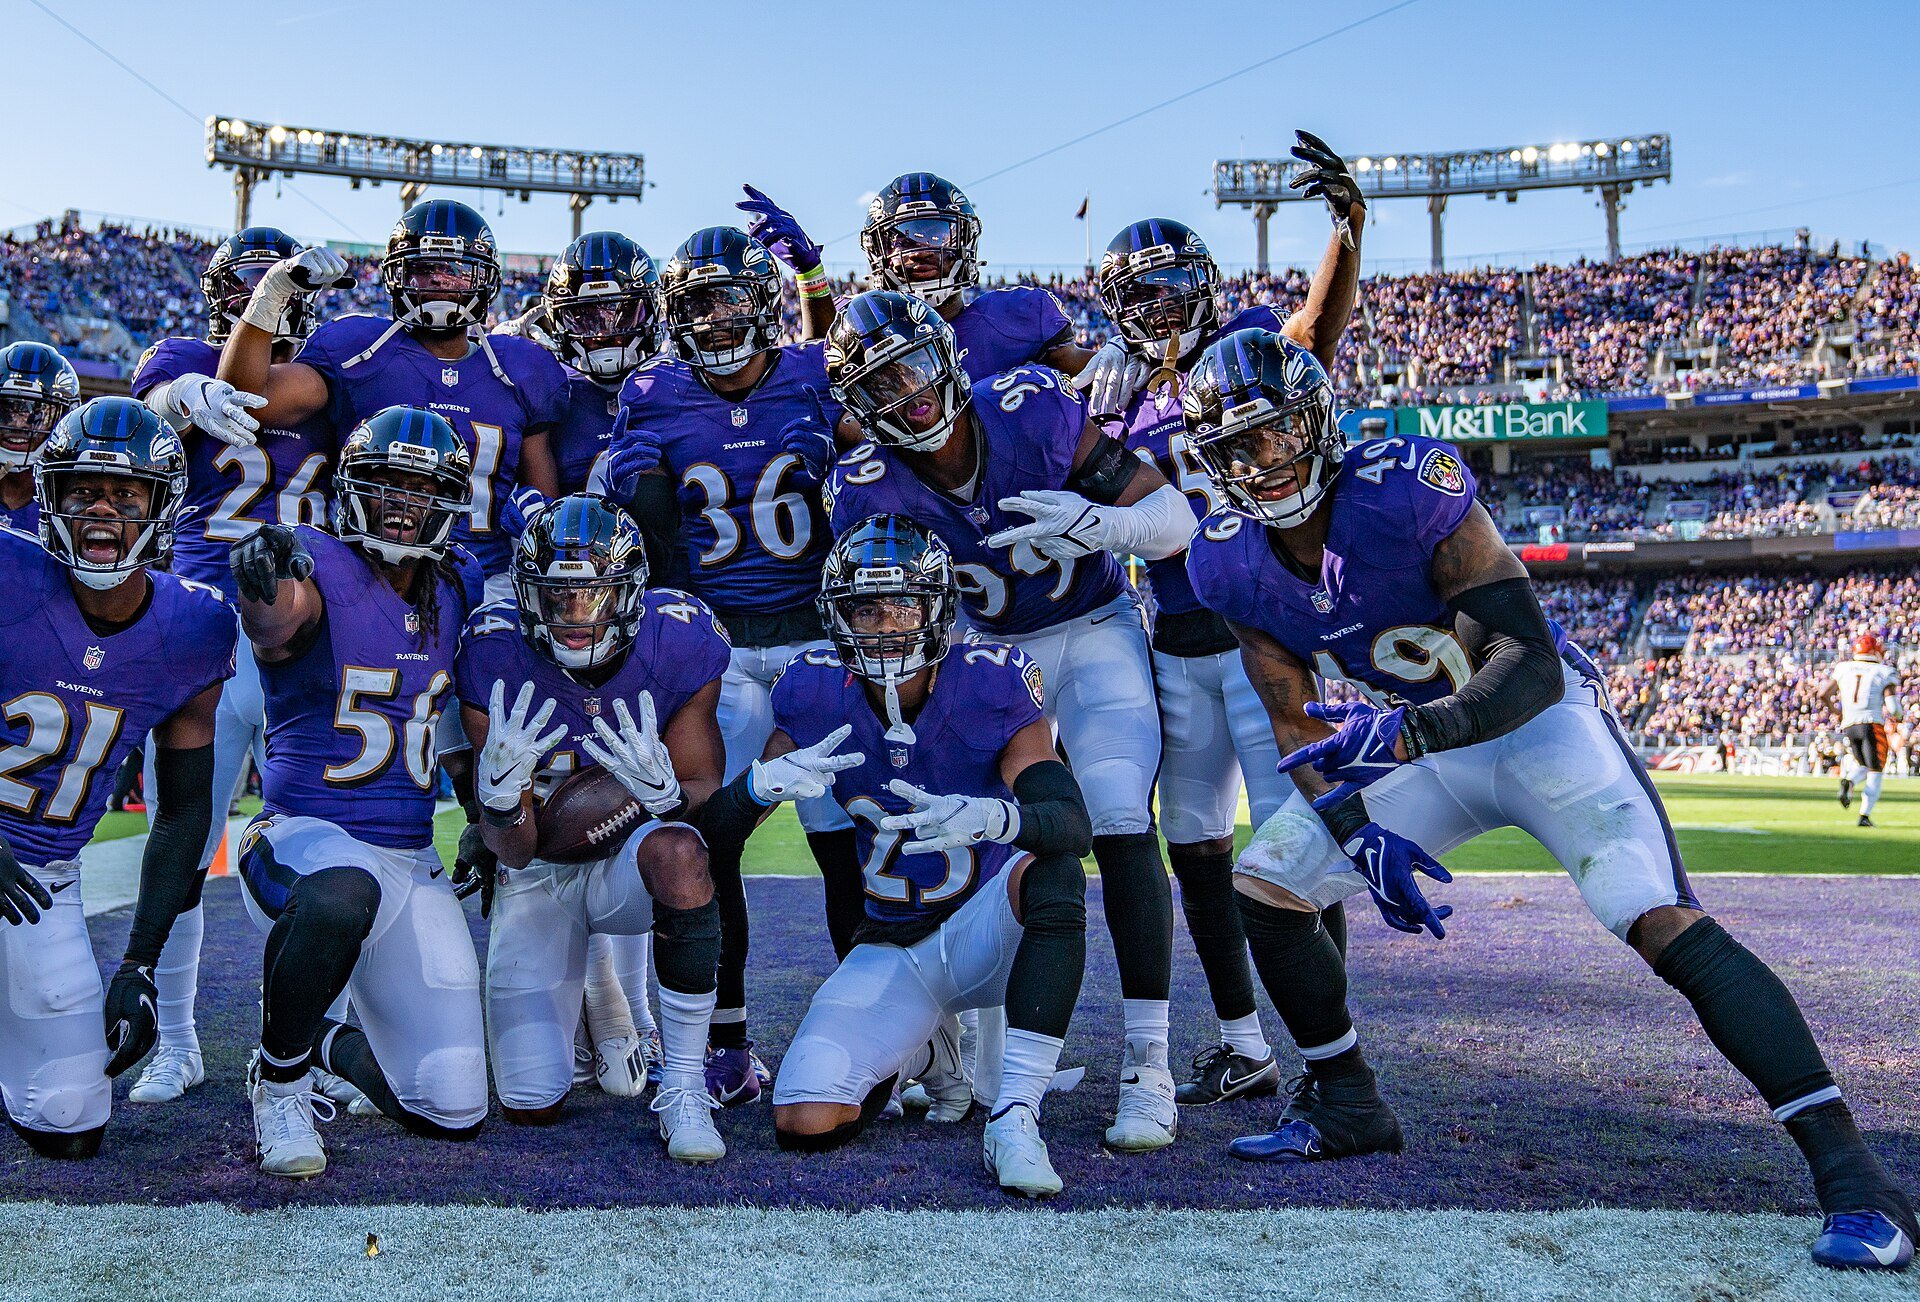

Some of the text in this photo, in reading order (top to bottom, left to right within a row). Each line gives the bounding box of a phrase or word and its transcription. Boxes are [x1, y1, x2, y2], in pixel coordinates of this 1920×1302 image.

[429, 402, 471, 414] RAVENS
[1147, 420, 1183, 437] RAVENS
[1416, 402, 1588, 440] M&T Bank
[263, 427, 301, 440] RAVENS
[400, 445, 428, 456] RAVENS
[722, 439, 766, 450] RAVENS
[90, 452, 118, 461] RAVENS
[1422, 451, 1441, 478] RAVENS
[468, 420, 503, 532] 1
[203, 442, 329, 542] 26
[682, 453, 813, 566] 36
[559, 562, 584, 571] RAVENS
[1320, 622, 1364, 641] RAVENS
[395, 653, 429, 661] RAVENS
[54, 679, 105, 697] RAVENS
[1853, 673, 1863, 704] 1
[323, 664, 454, 790] 56
[0, 690, 126, 824] 21
